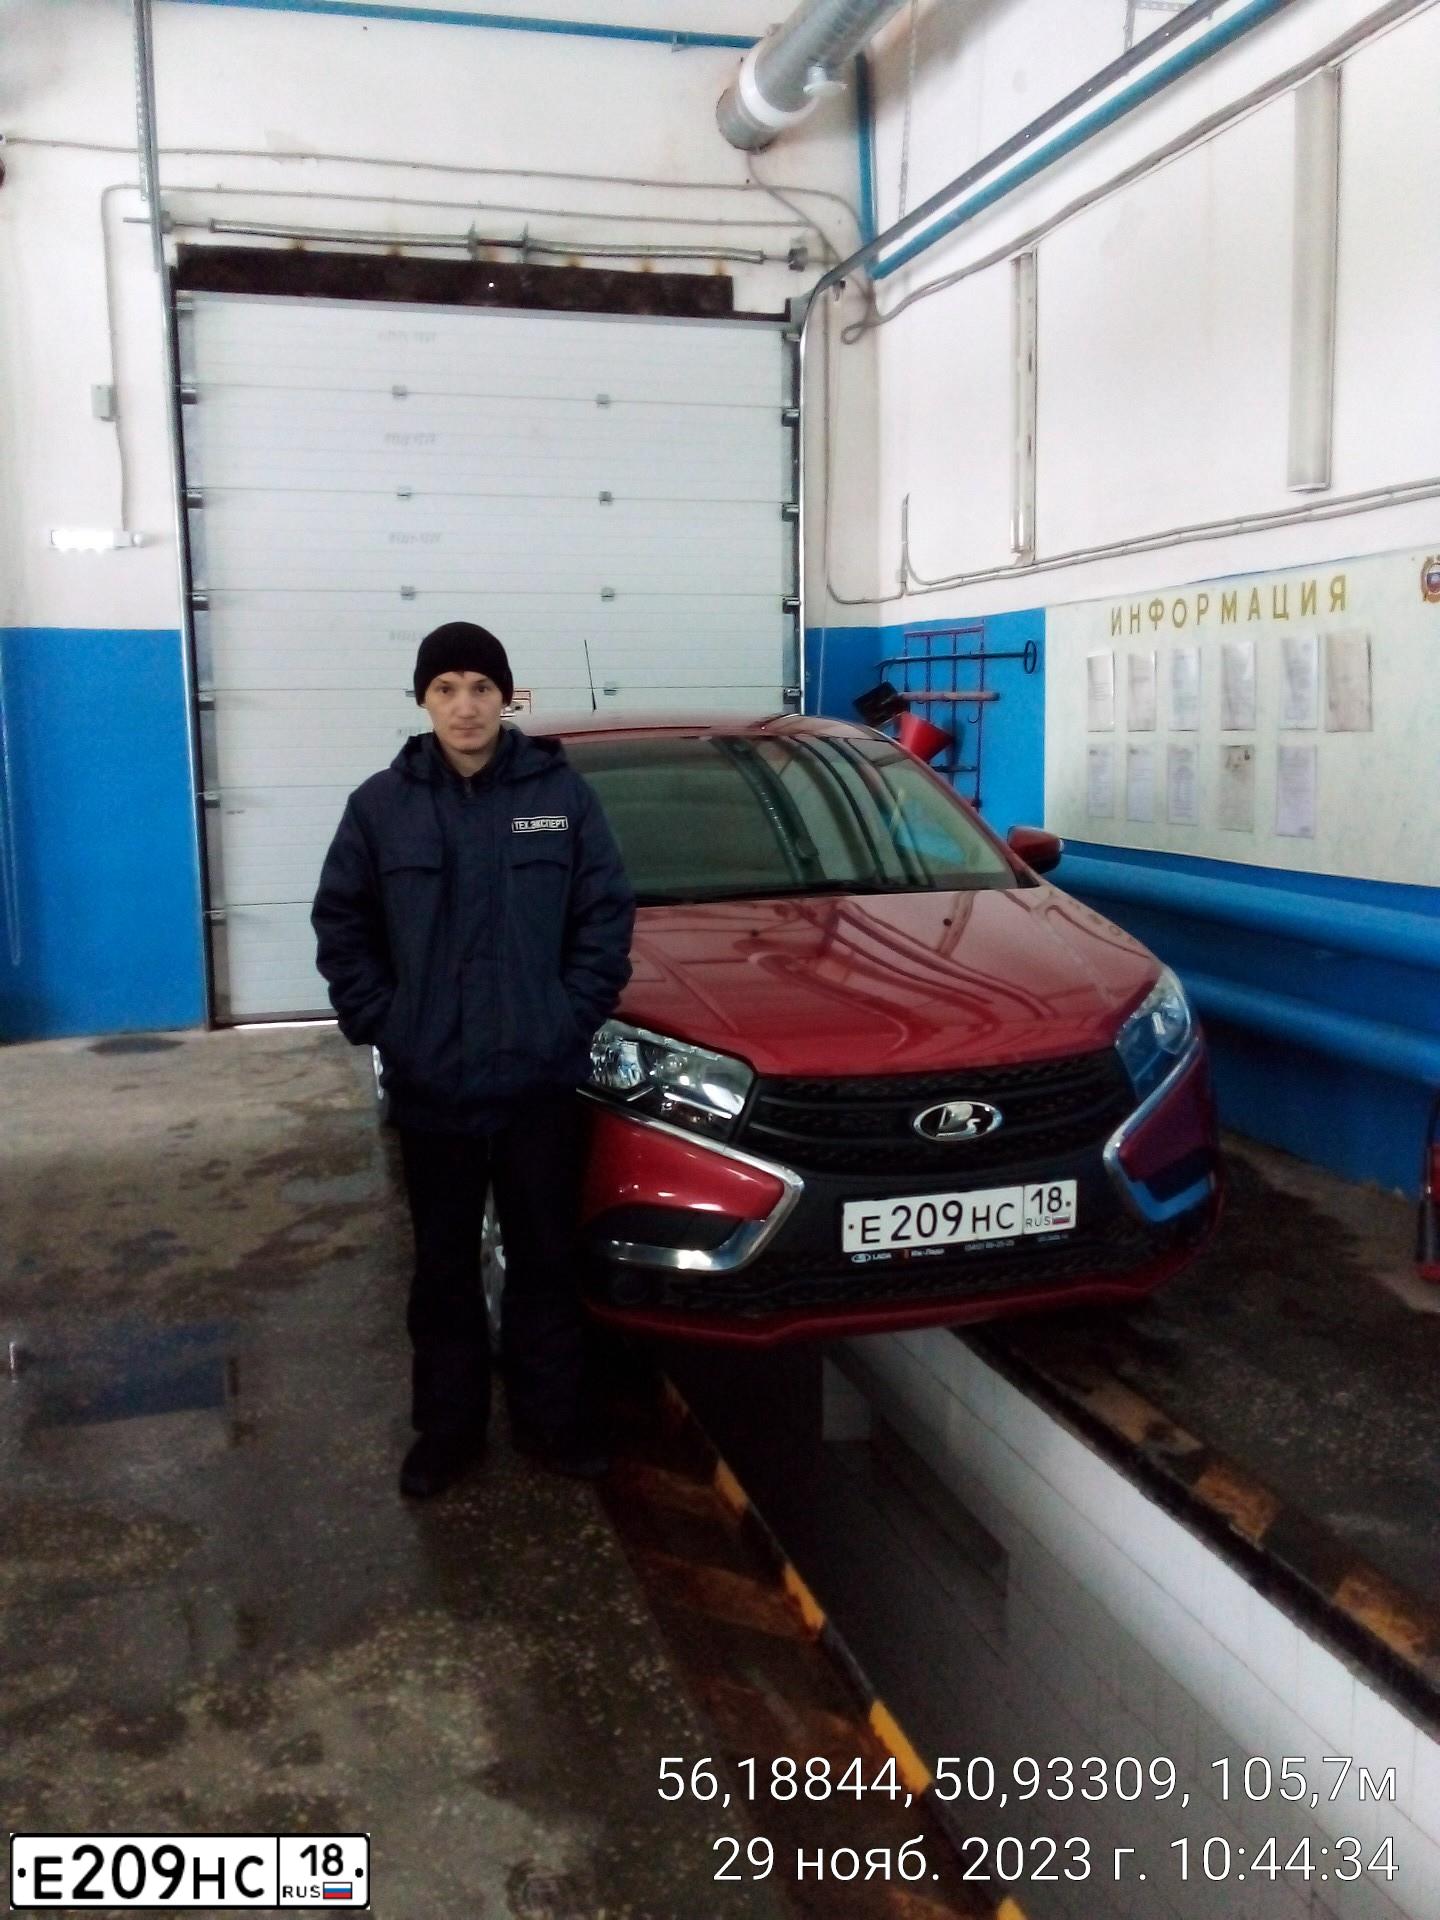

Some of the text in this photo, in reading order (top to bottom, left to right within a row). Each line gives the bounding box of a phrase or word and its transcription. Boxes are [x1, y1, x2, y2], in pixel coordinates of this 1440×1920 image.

[1111, 574, 1347, 636] ИНФОРМАЦИЯ
[1030, 1186, 1062, 1215] 18
[1025, 1216, 1050, 1228] RUS
